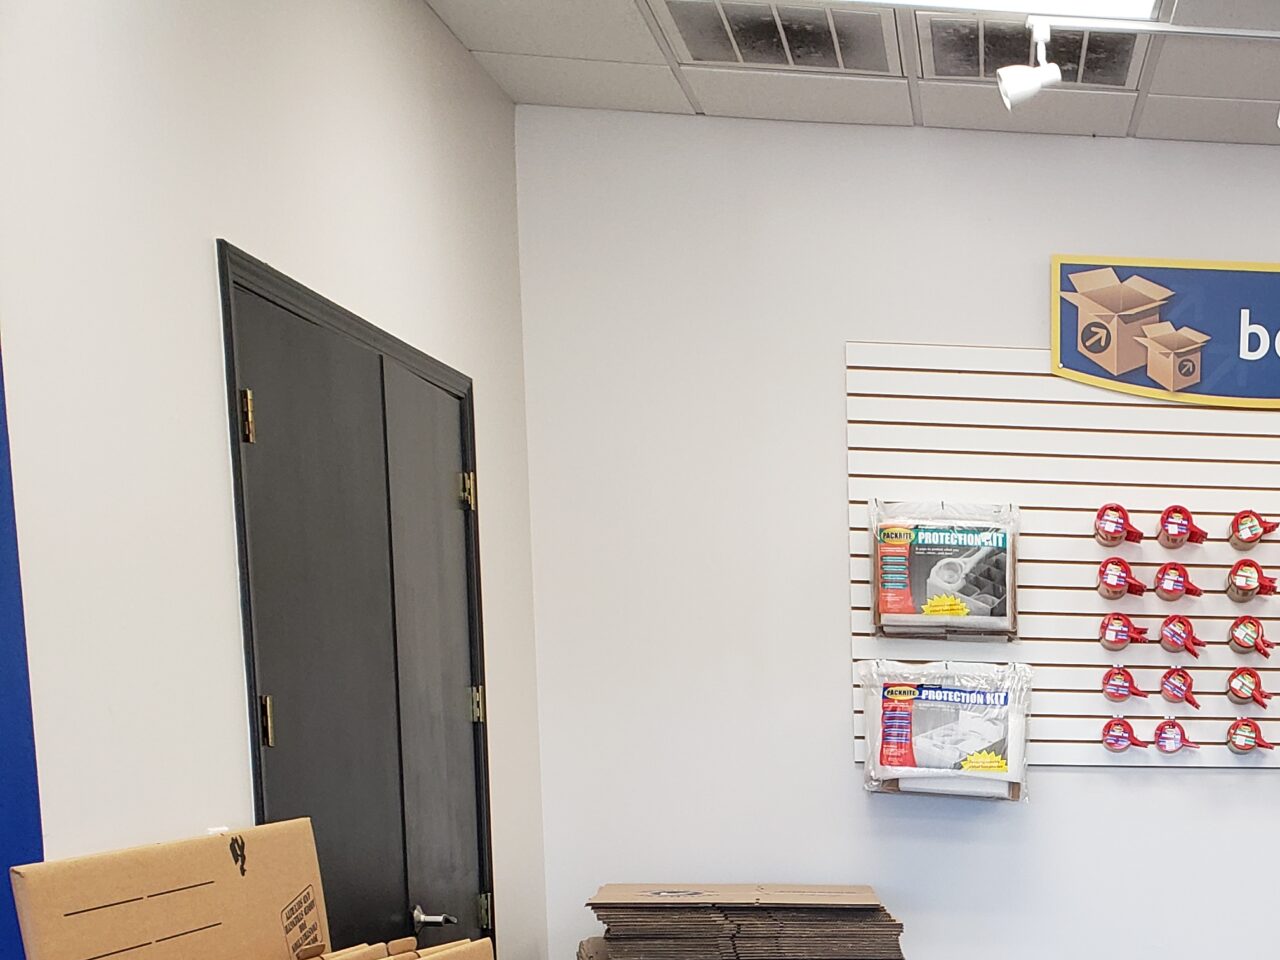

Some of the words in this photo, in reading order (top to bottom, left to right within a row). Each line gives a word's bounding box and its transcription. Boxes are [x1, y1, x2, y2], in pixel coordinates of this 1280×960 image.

[882, 531, 912, 539] PACKRITE
[918, 531, 980, 546] PROTECTION
[922, 689, 983, 706] PROTECTION
[985, 692, 1006, 706] KIT
